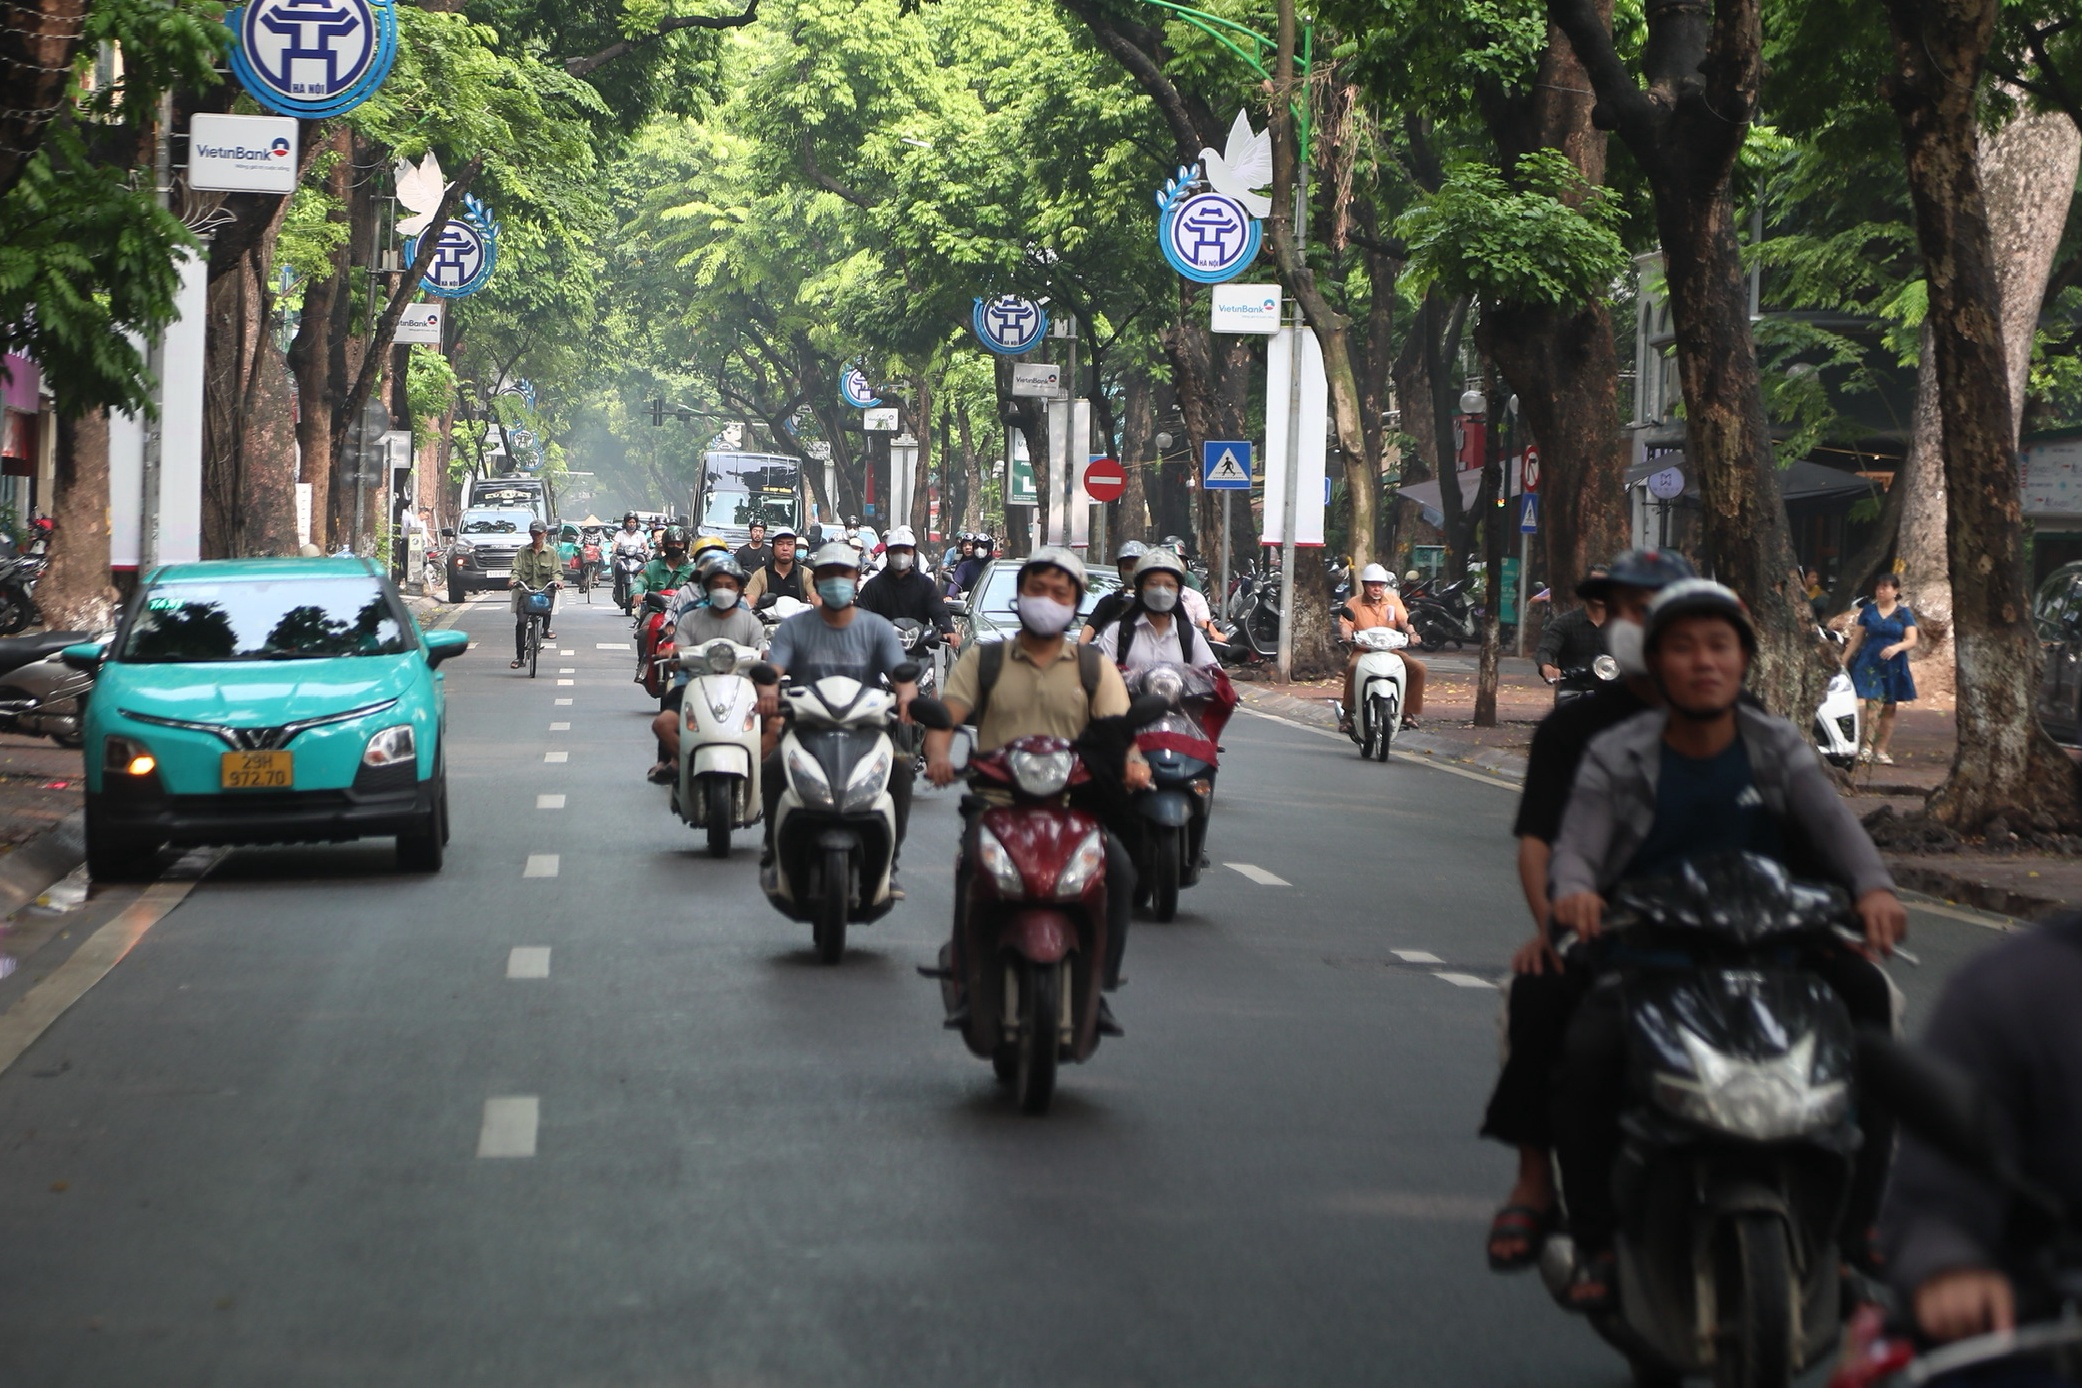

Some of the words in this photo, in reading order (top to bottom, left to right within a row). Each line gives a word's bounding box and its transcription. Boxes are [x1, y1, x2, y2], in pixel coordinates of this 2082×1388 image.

[196, 144, 271, 161] VietinBank
[1219, 304, 1264, 313] VietinBank
[399, 319, 428, 327] tinBank
